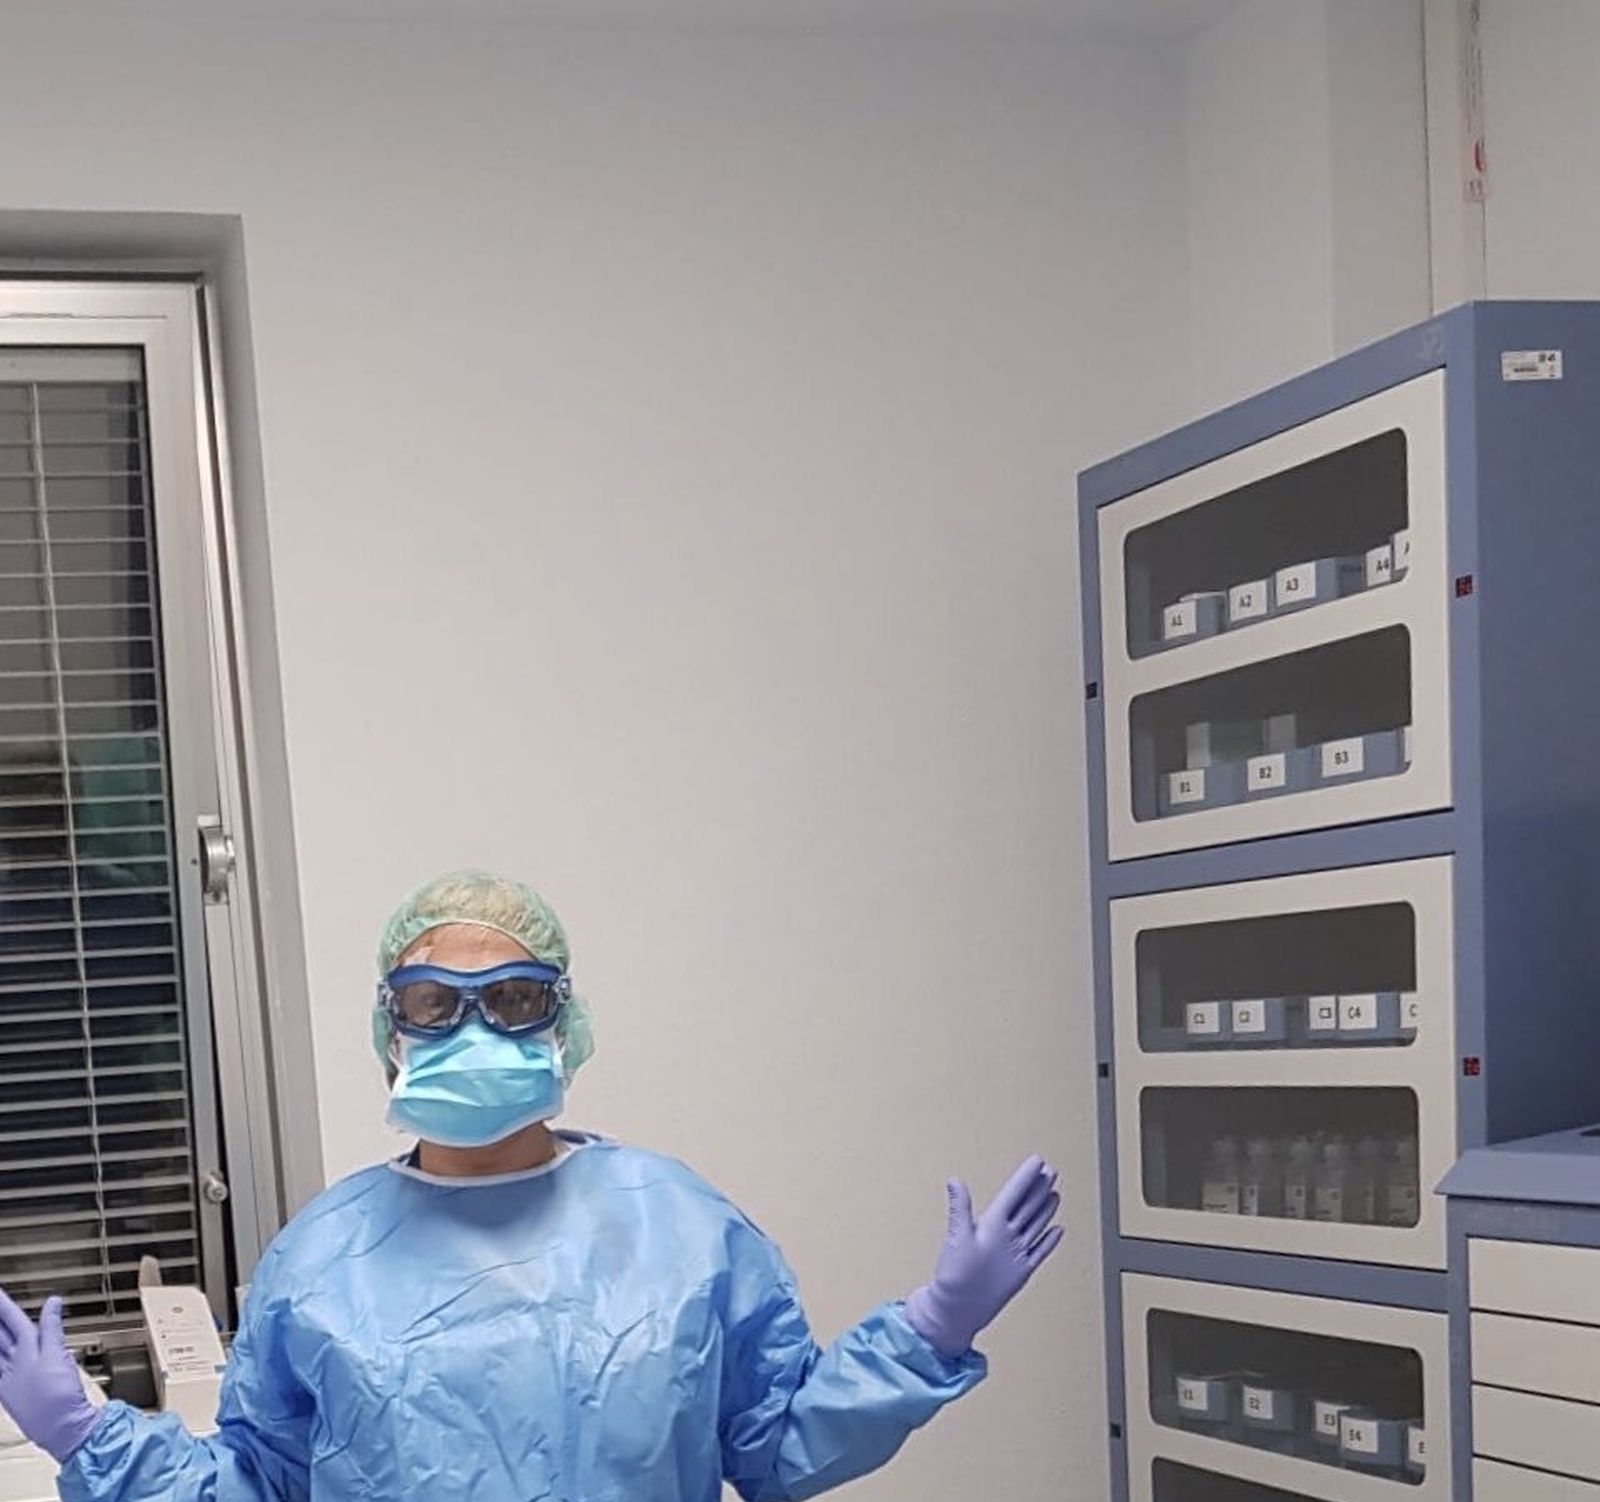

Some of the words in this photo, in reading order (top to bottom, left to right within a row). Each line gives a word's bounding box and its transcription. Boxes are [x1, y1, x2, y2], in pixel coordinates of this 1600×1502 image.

[1376, 558, 1389, 572] A4
[1285, 577, 1299, 591] A3
[1240, 594, 1252, 608] A2
[1172, 613, 1183, 627] A1
[1335, 751, 1349, 765] B3
[1259, 766, 1272, 779] B2
[1180, 780, 1191, 793] B1
